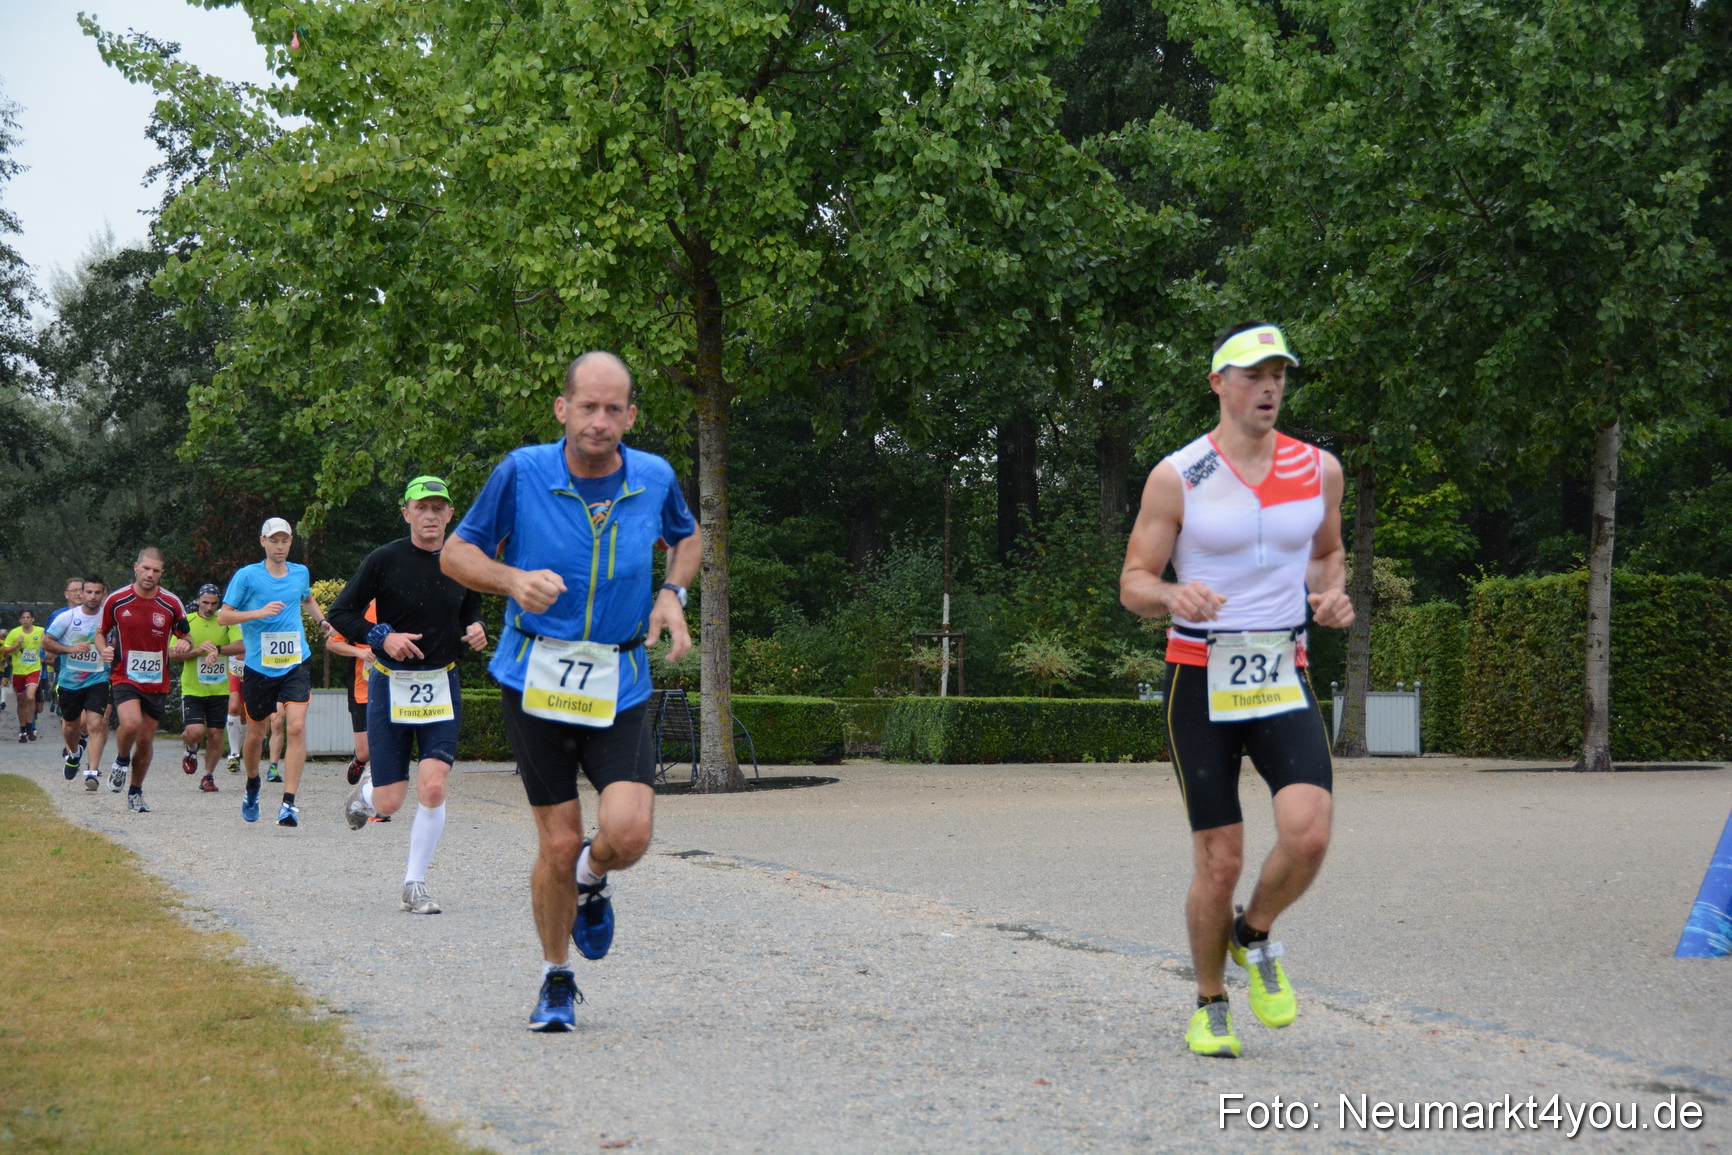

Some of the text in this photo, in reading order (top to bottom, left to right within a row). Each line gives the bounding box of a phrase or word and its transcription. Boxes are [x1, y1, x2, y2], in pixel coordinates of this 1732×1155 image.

[270, 640, 294, 655] 200
[131, 659, 161, 672] 2425
[200, 663, 225, 674] 2526
[1229, 653, 1282, 685] 234
[558, 658, 594, 690] 77
[409, 683, 434, 704] 23
[1231, 692, 1281, 708] Thorsten
[547, 694, 593, 713] Christof
[399, 707, 445, 717] Franz Xaver
